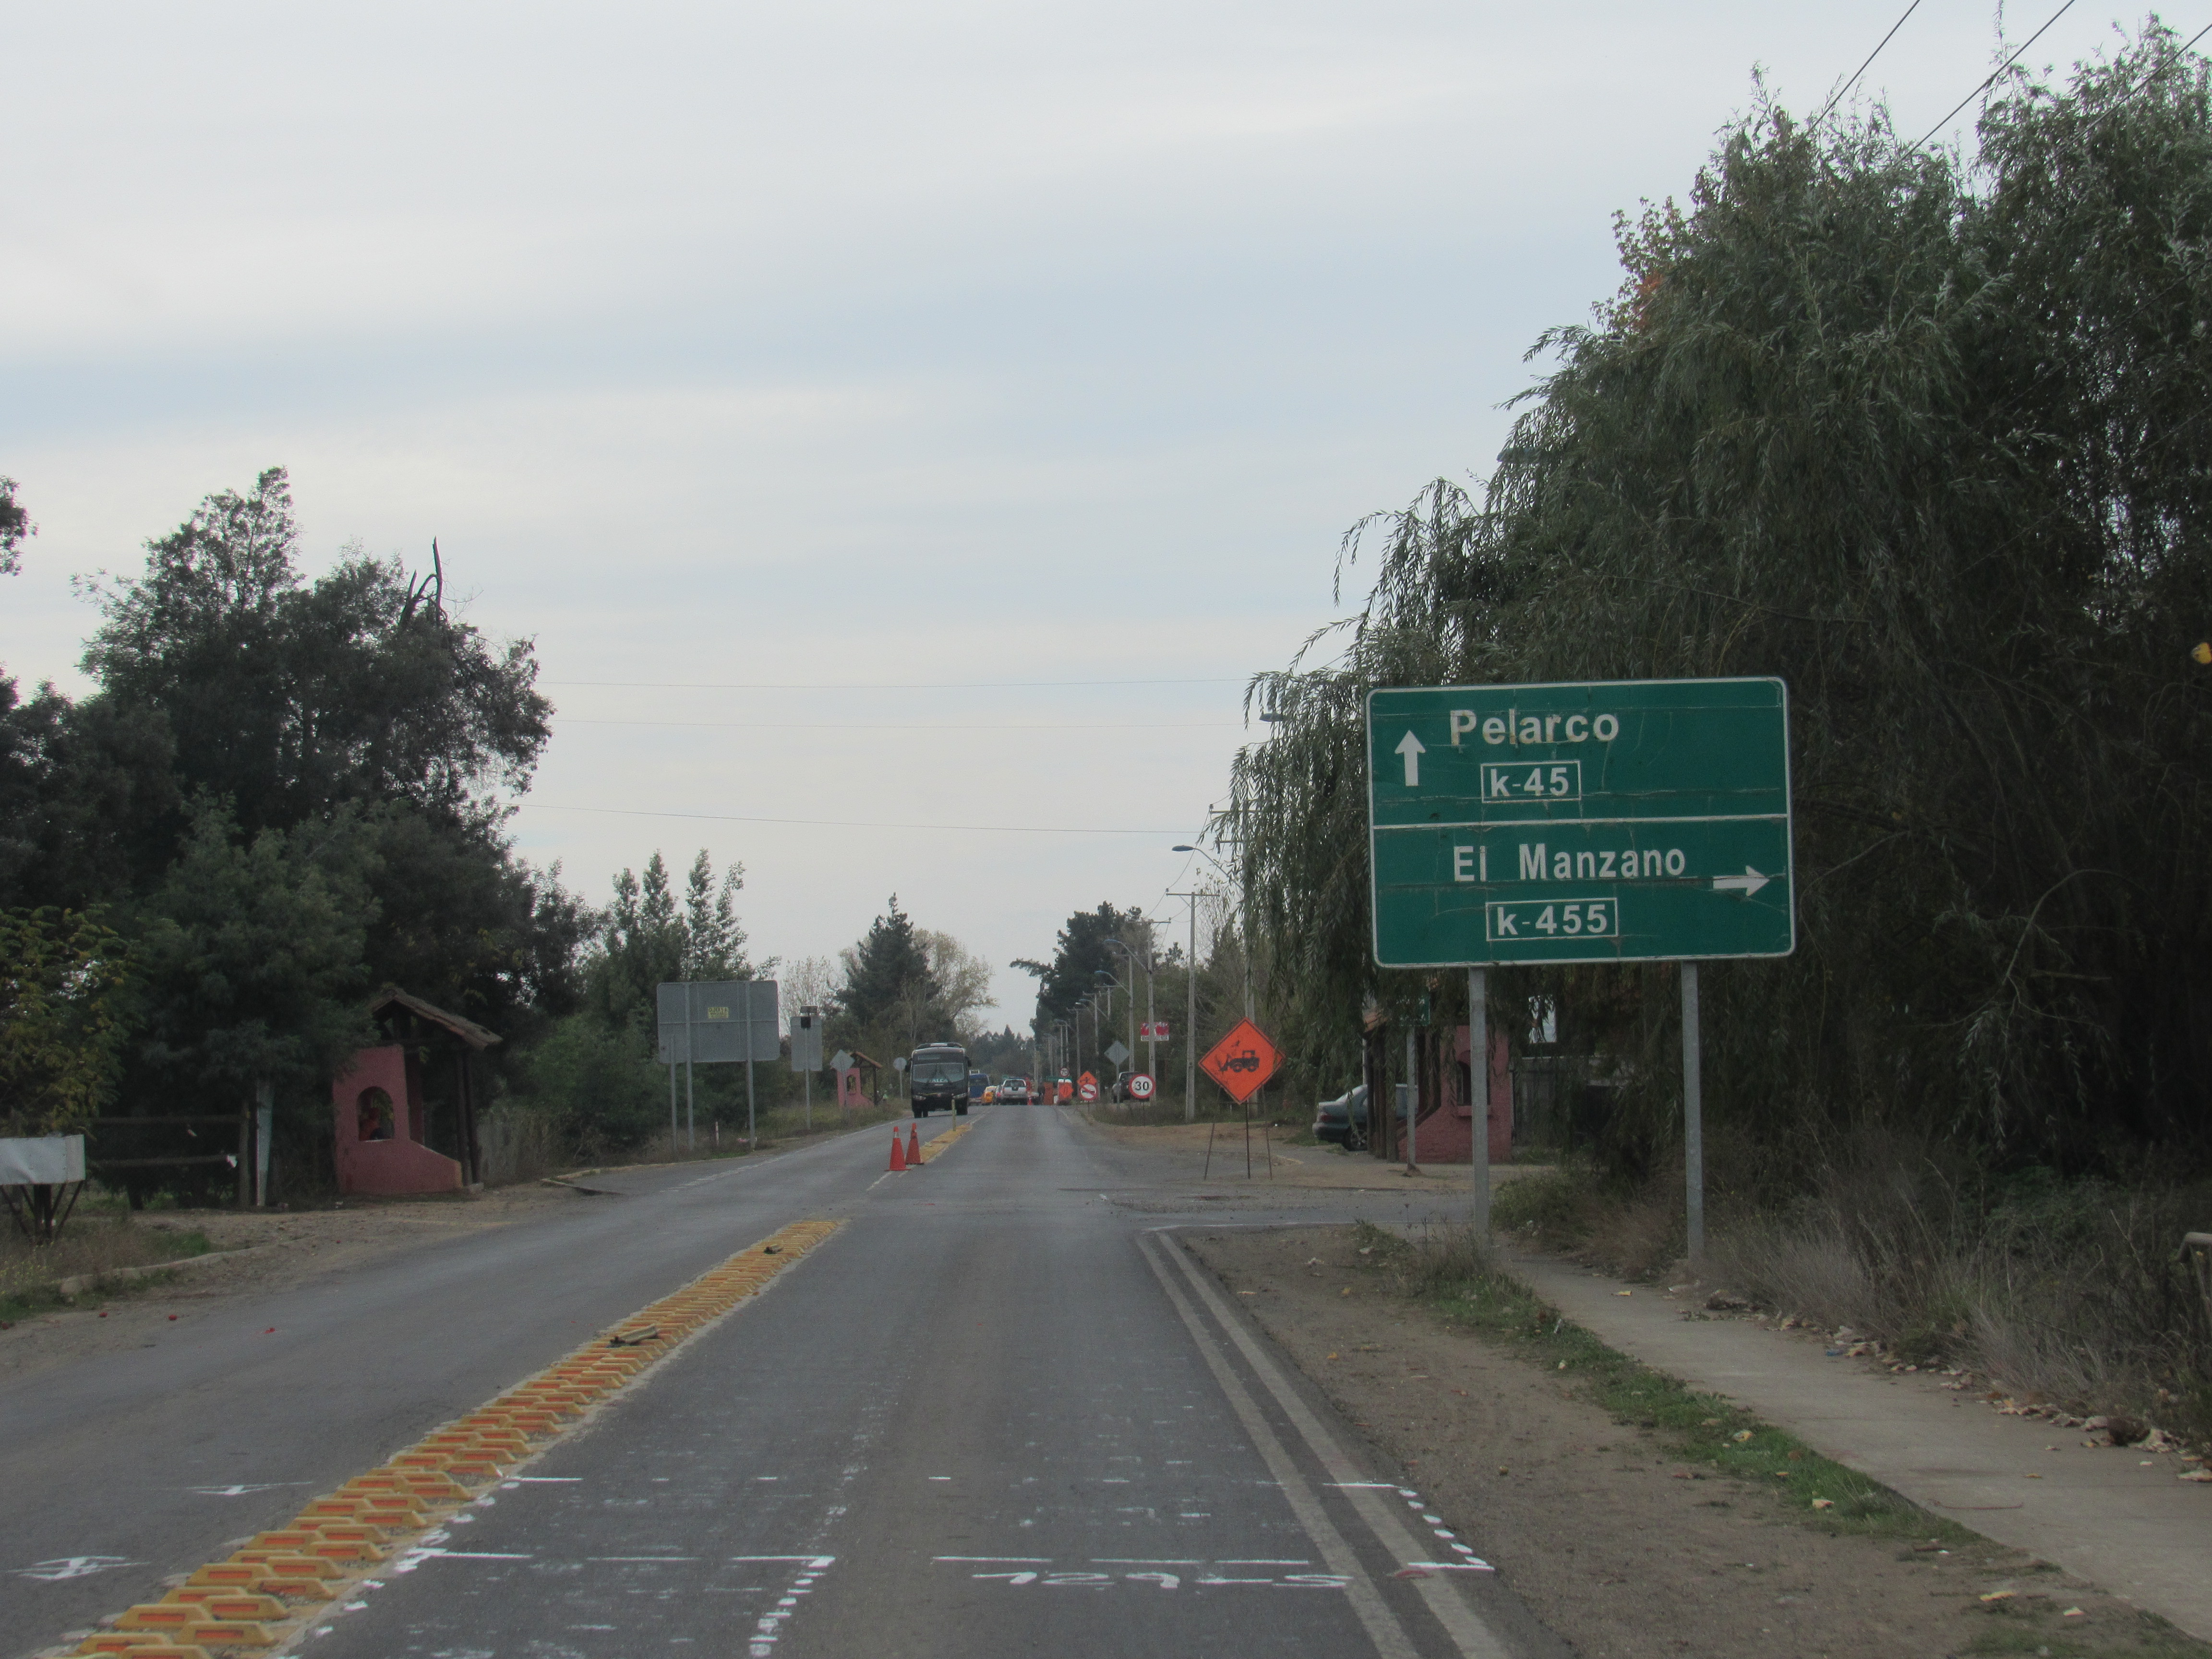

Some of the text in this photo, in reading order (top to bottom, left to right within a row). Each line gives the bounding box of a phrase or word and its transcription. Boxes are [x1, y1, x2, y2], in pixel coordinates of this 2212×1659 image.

[1451, 708, 1619, 745] Pelarco
[1490, 767, 1569, 797] k-45
[1454, 843, 1686, 882] El Manzano
[1497, 904, 1608, 936] k-455
[1135, 1081, 1149, 1091] 30
